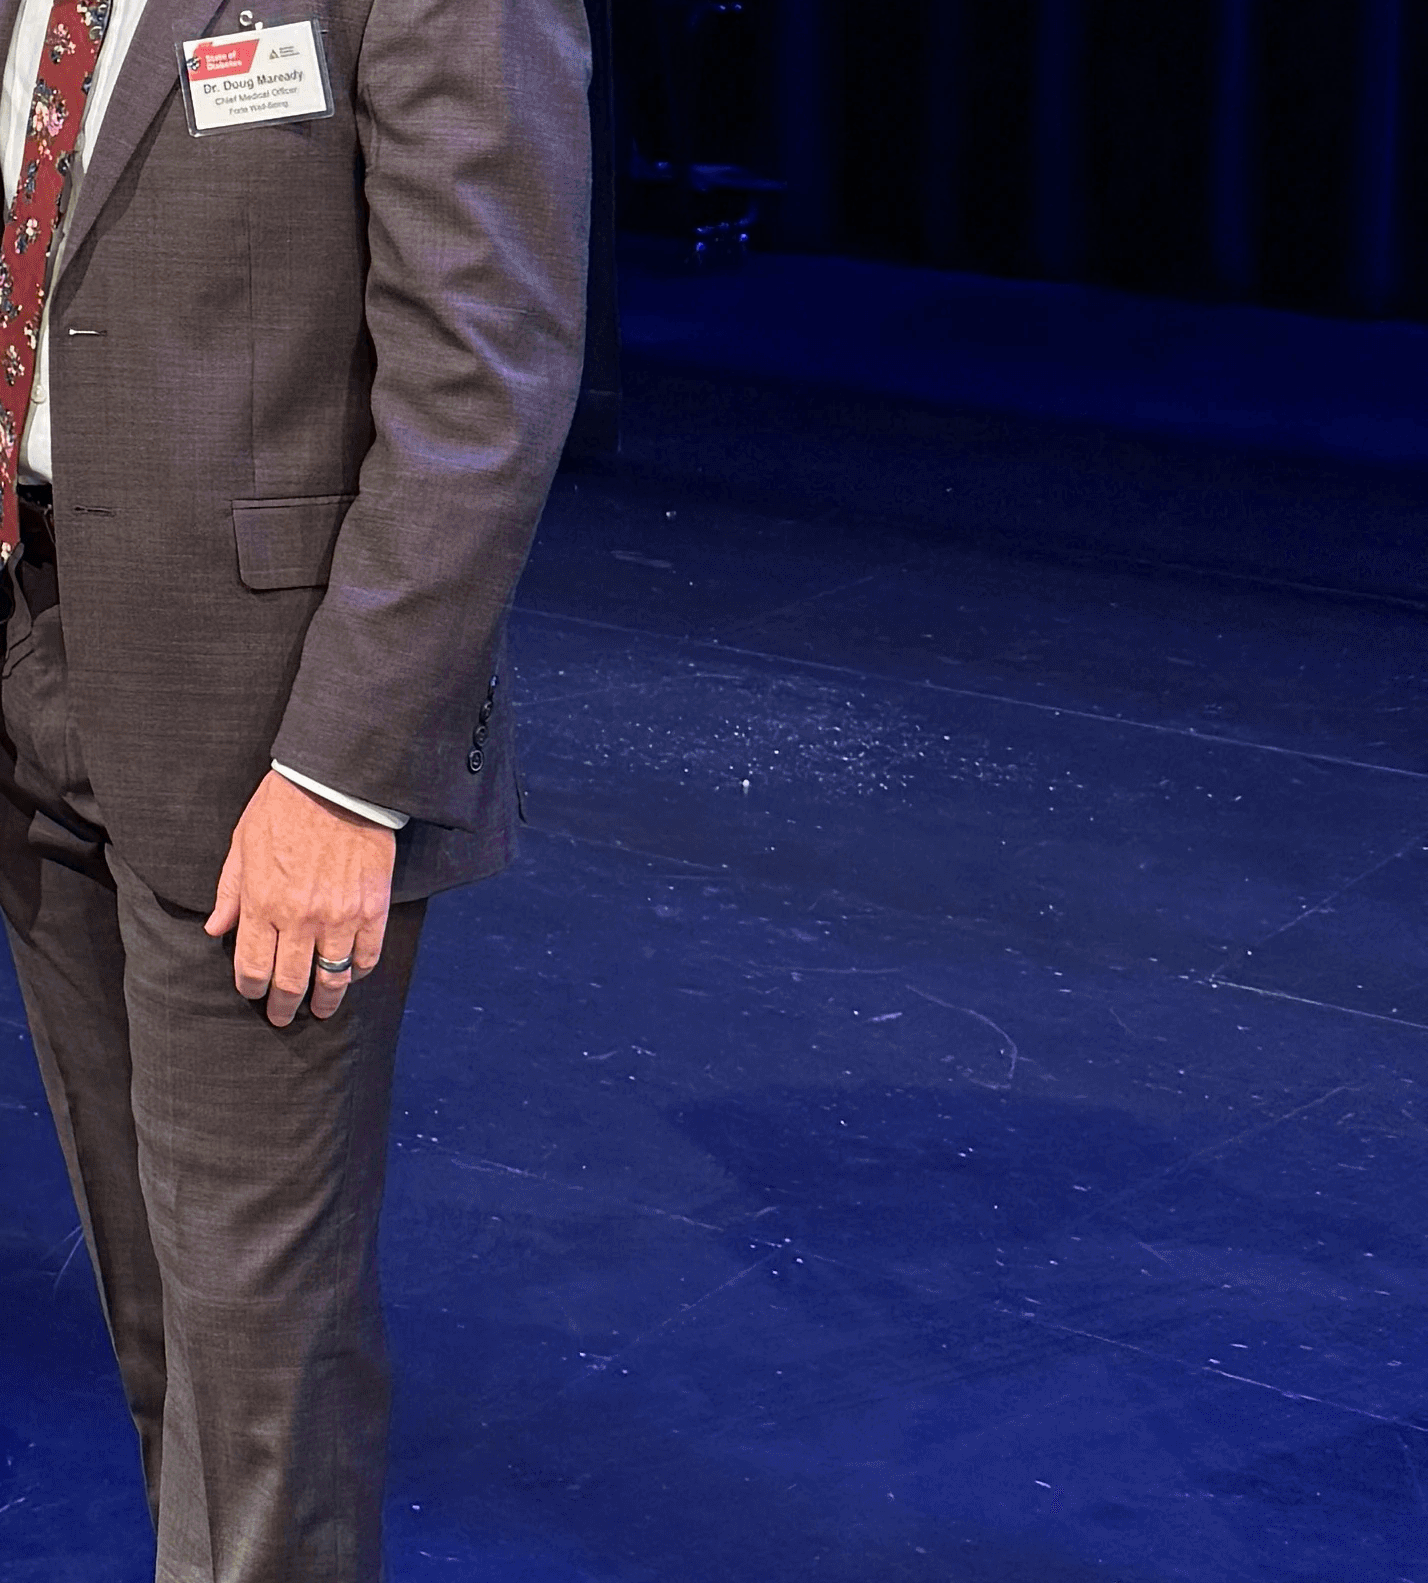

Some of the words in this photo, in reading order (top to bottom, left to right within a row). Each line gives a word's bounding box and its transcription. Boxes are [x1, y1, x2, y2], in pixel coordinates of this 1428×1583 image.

[204, 83, 220, 94] Dr.
[224, 79, 254, 90] Doug
[257, 70, 303, 85] Maready
